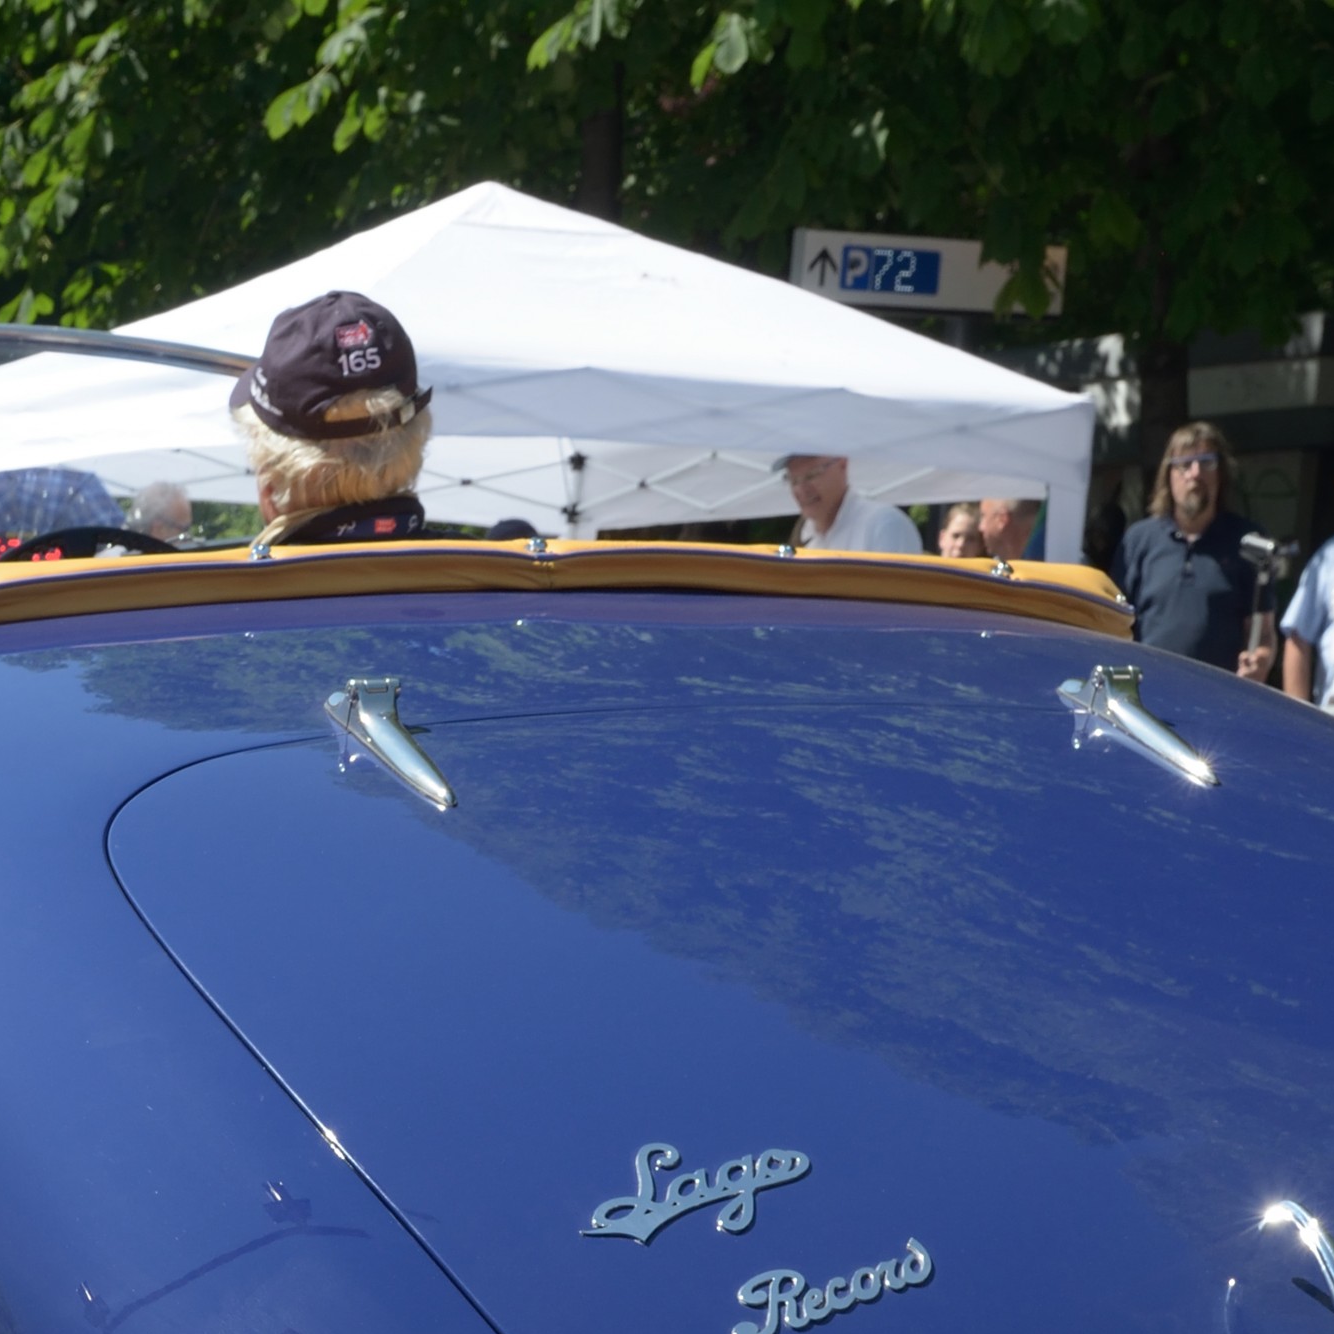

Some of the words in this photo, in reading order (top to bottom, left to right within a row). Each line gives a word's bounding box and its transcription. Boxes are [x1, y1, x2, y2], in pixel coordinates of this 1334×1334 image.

[873, 248, 917, 293] 72
[337, 347, 382, 377] 165
[579, 1142, 812, 1246] Lago
